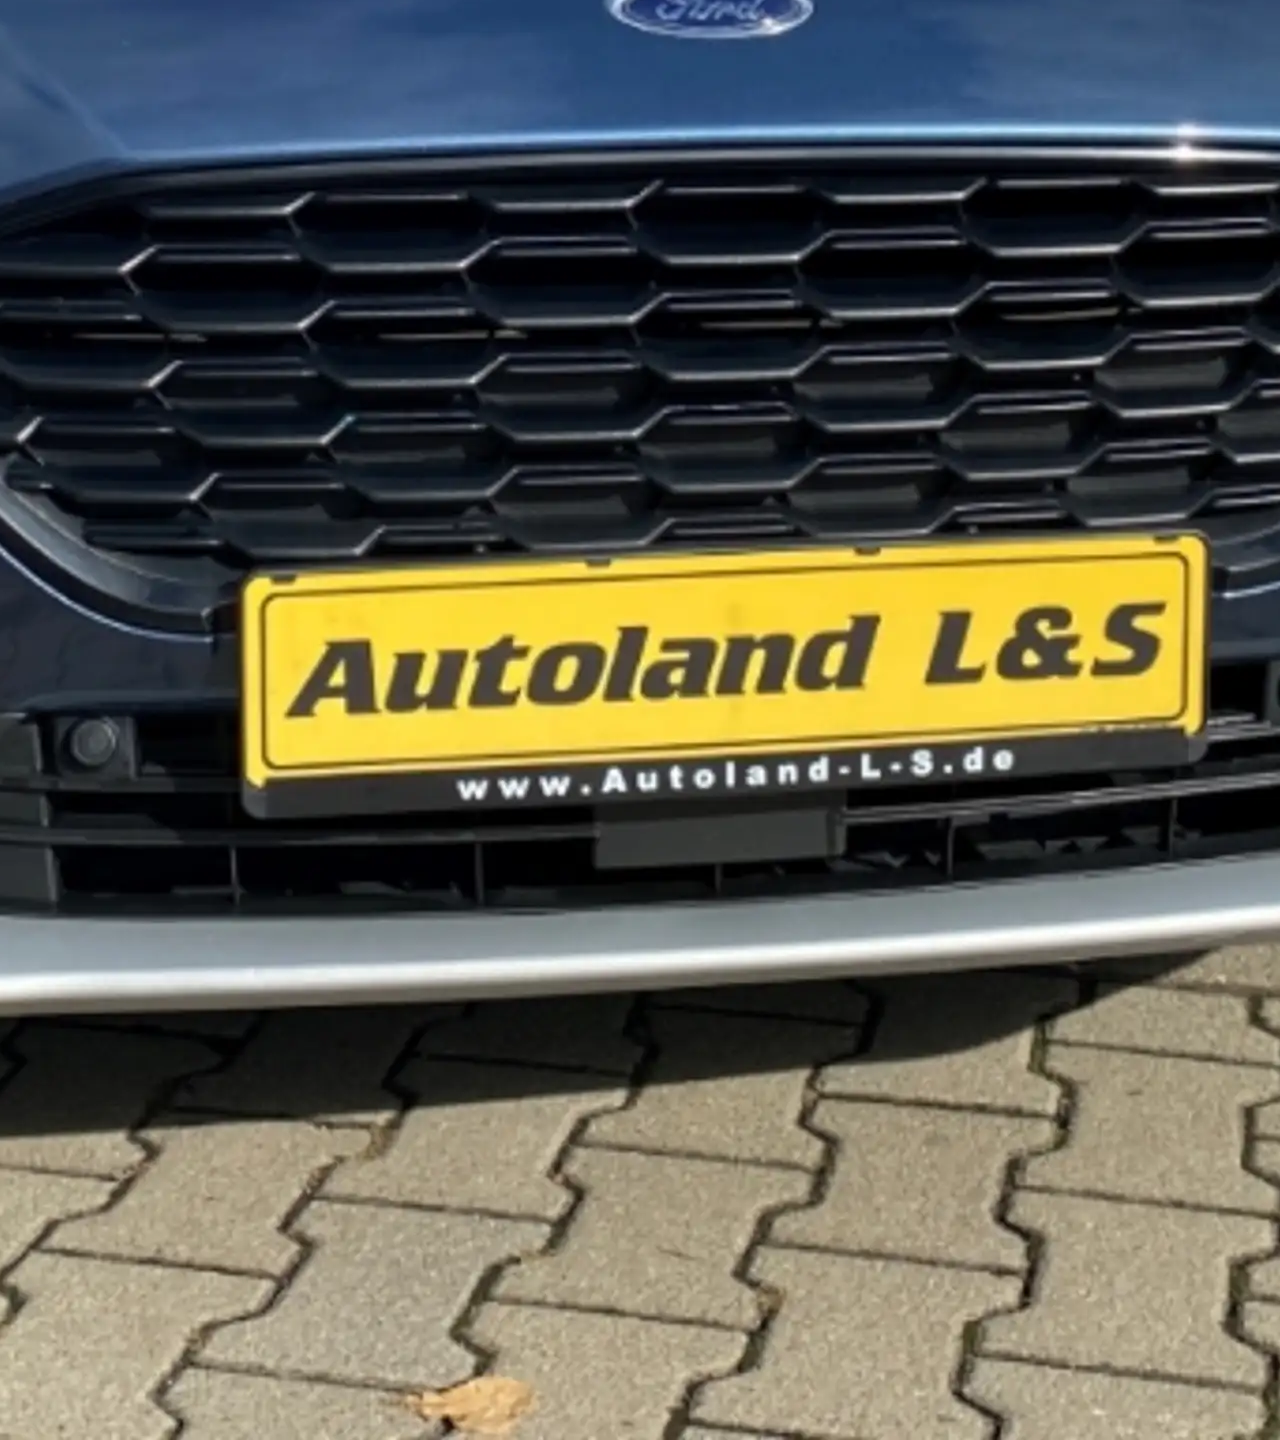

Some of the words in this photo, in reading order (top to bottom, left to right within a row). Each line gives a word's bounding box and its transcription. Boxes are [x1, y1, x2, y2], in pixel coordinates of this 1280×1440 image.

[286, 614, 880, 718] Autoland
[924, 601, 1168, 685] L&S
[457, 748, 1016, 801] www.Autoland-L-S.de
